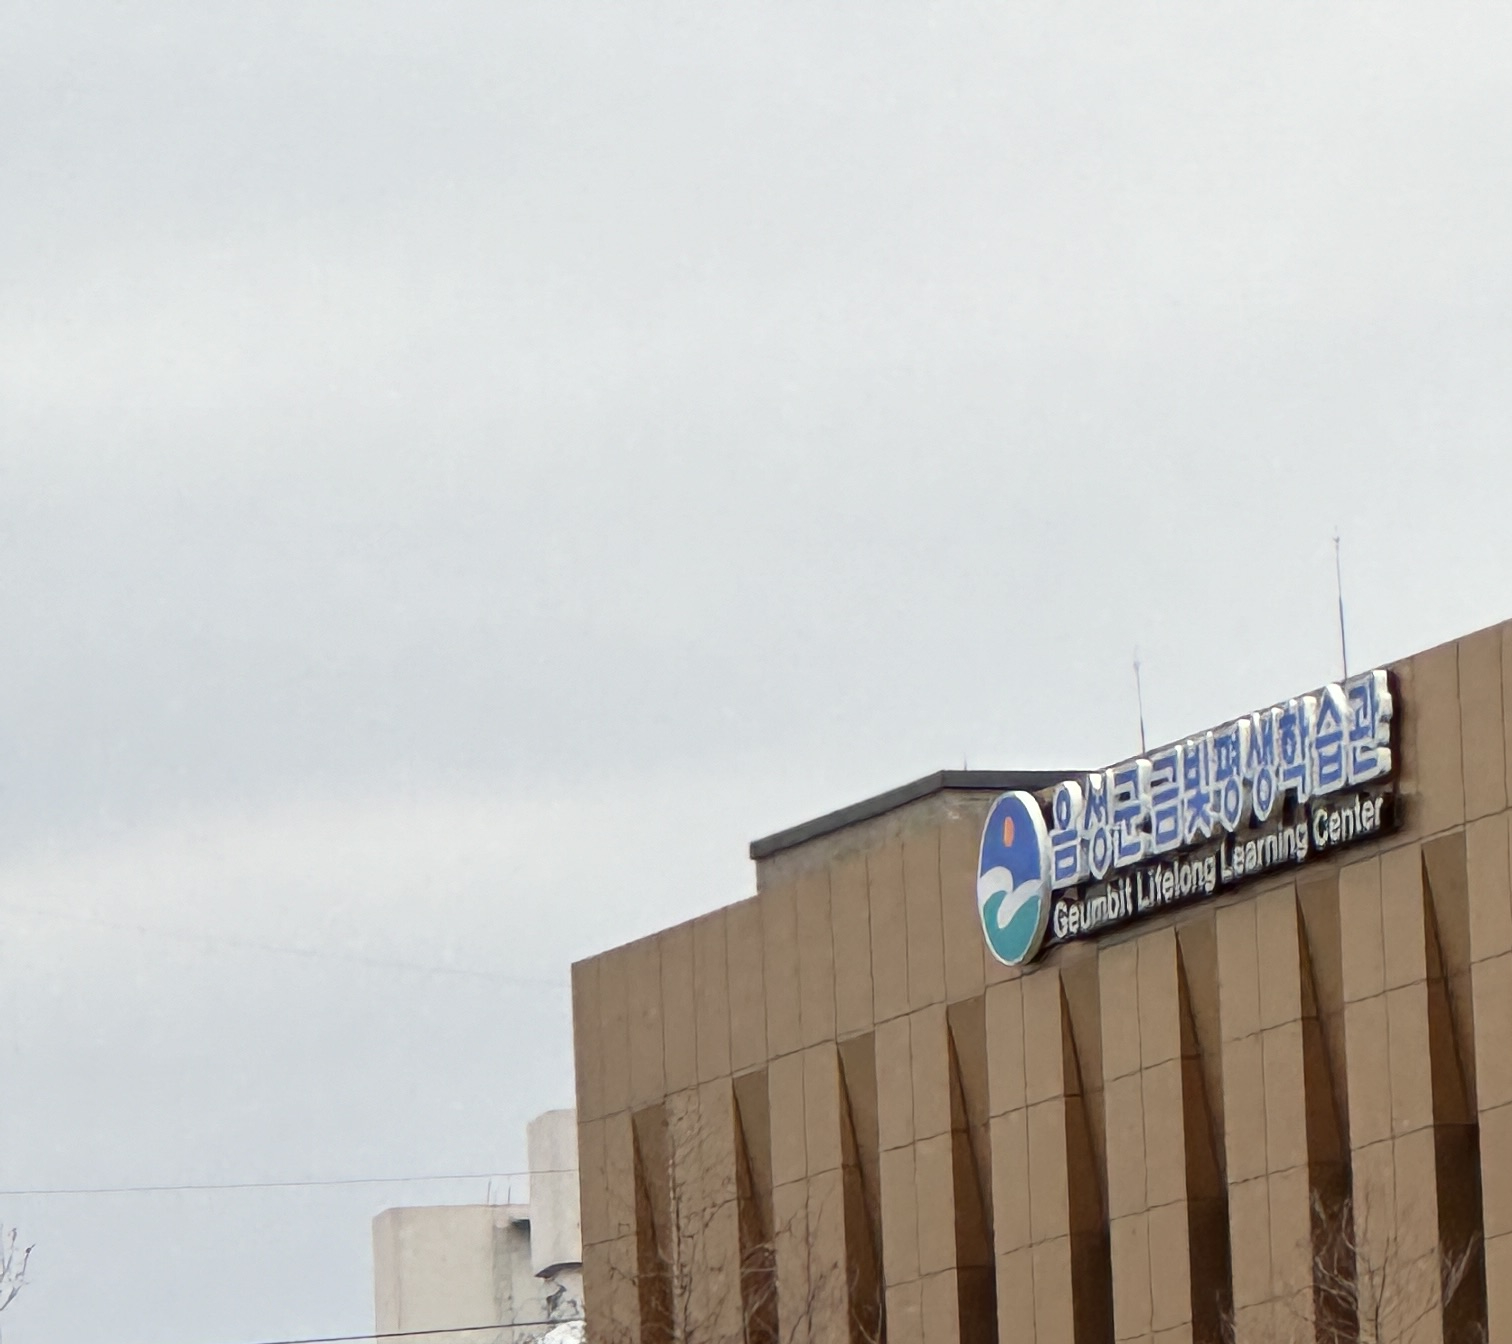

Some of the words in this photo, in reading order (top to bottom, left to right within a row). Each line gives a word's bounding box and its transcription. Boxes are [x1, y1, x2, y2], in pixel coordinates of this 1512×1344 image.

[1053, 876, 1133, 939] Geumbit
[1136, 854, 1217, 912] Lifelong
[1220, 822, 1309, 884] Learning
[1313, 795, 1383, 850] Center
